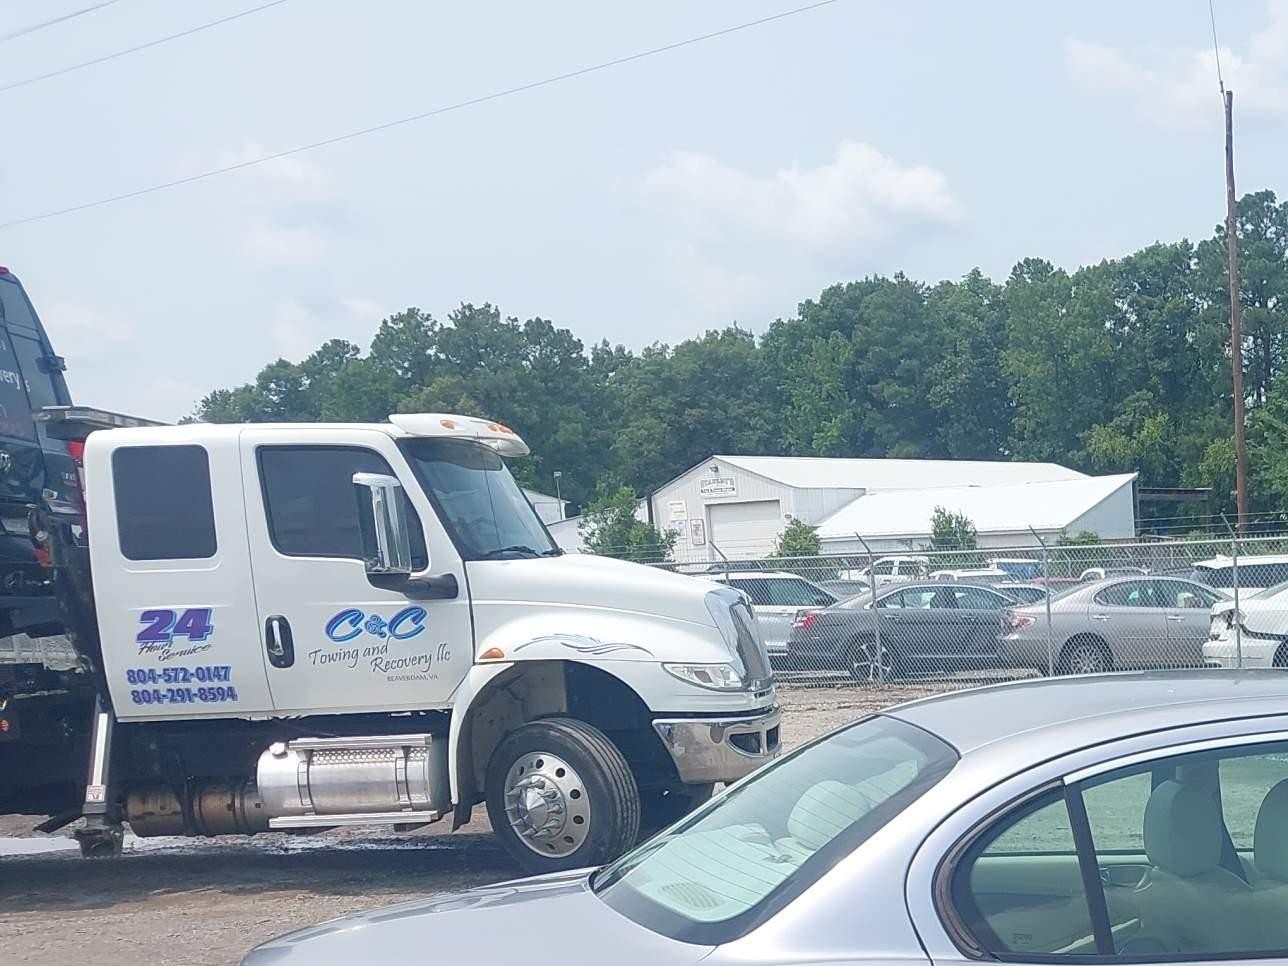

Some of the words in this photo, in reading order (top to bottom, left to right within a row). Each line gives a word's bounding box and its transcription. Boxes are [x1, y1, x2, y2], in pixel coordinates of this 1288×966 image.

[136, 607, 214, 643] 24
[325, 606, 427, 643] C&C
[158, 644, 212, 662] Service
[308, 649, 359, 668] Towing
[362, 635, 393, 658] and
[370, 653, 433, 673] Recovery
[436, 643, 451, 662] llc
[126, 665, 232, 685] 804-572-0147
[131, 686, 239, 705] 804-291-8594
